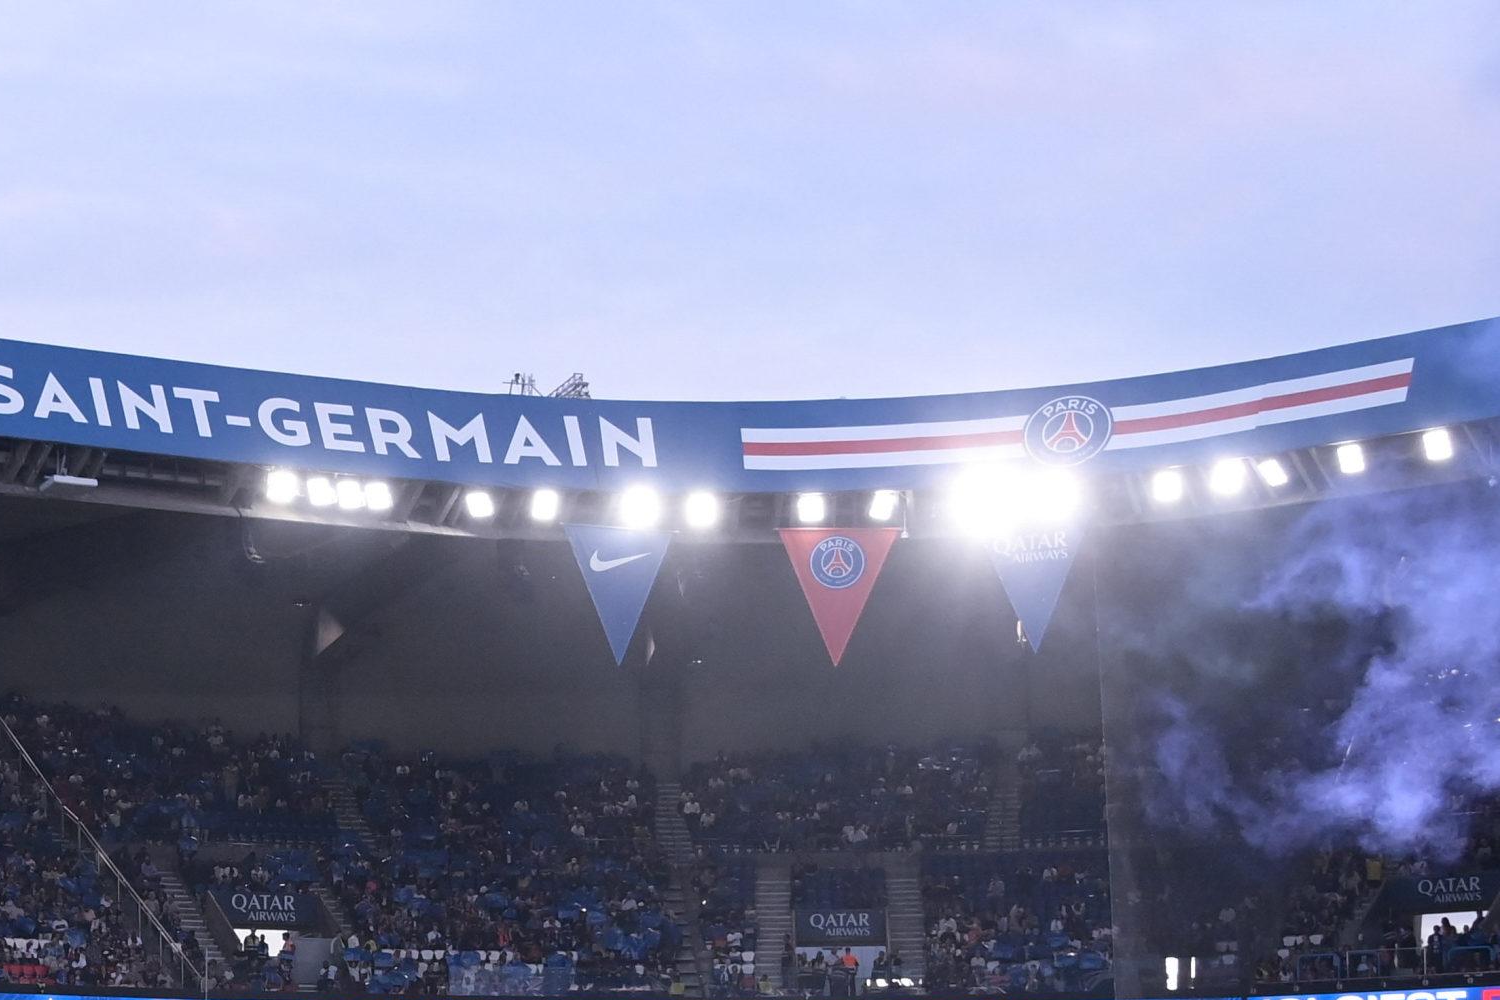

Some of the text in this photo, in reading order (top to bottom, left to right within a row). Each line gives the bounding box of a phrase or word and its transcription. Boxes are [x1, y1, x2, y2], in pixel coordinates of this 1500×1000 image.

[1041, 399, 1098, 418] PARIS
[819, 539, 855, 552] PARIS
[994, 530, 1068, 556] QATAR
[1418, 876, 1480, 896] QATAR
[231, 894, 295, 912] QATAR
[1434, 891, 1482, 903] AIRWAYS
[248, 911, 296, 922] AIRWAYS
[810, 913, 870, 930] QATAR
[825, 927, 870, 936] AIRWAYS
